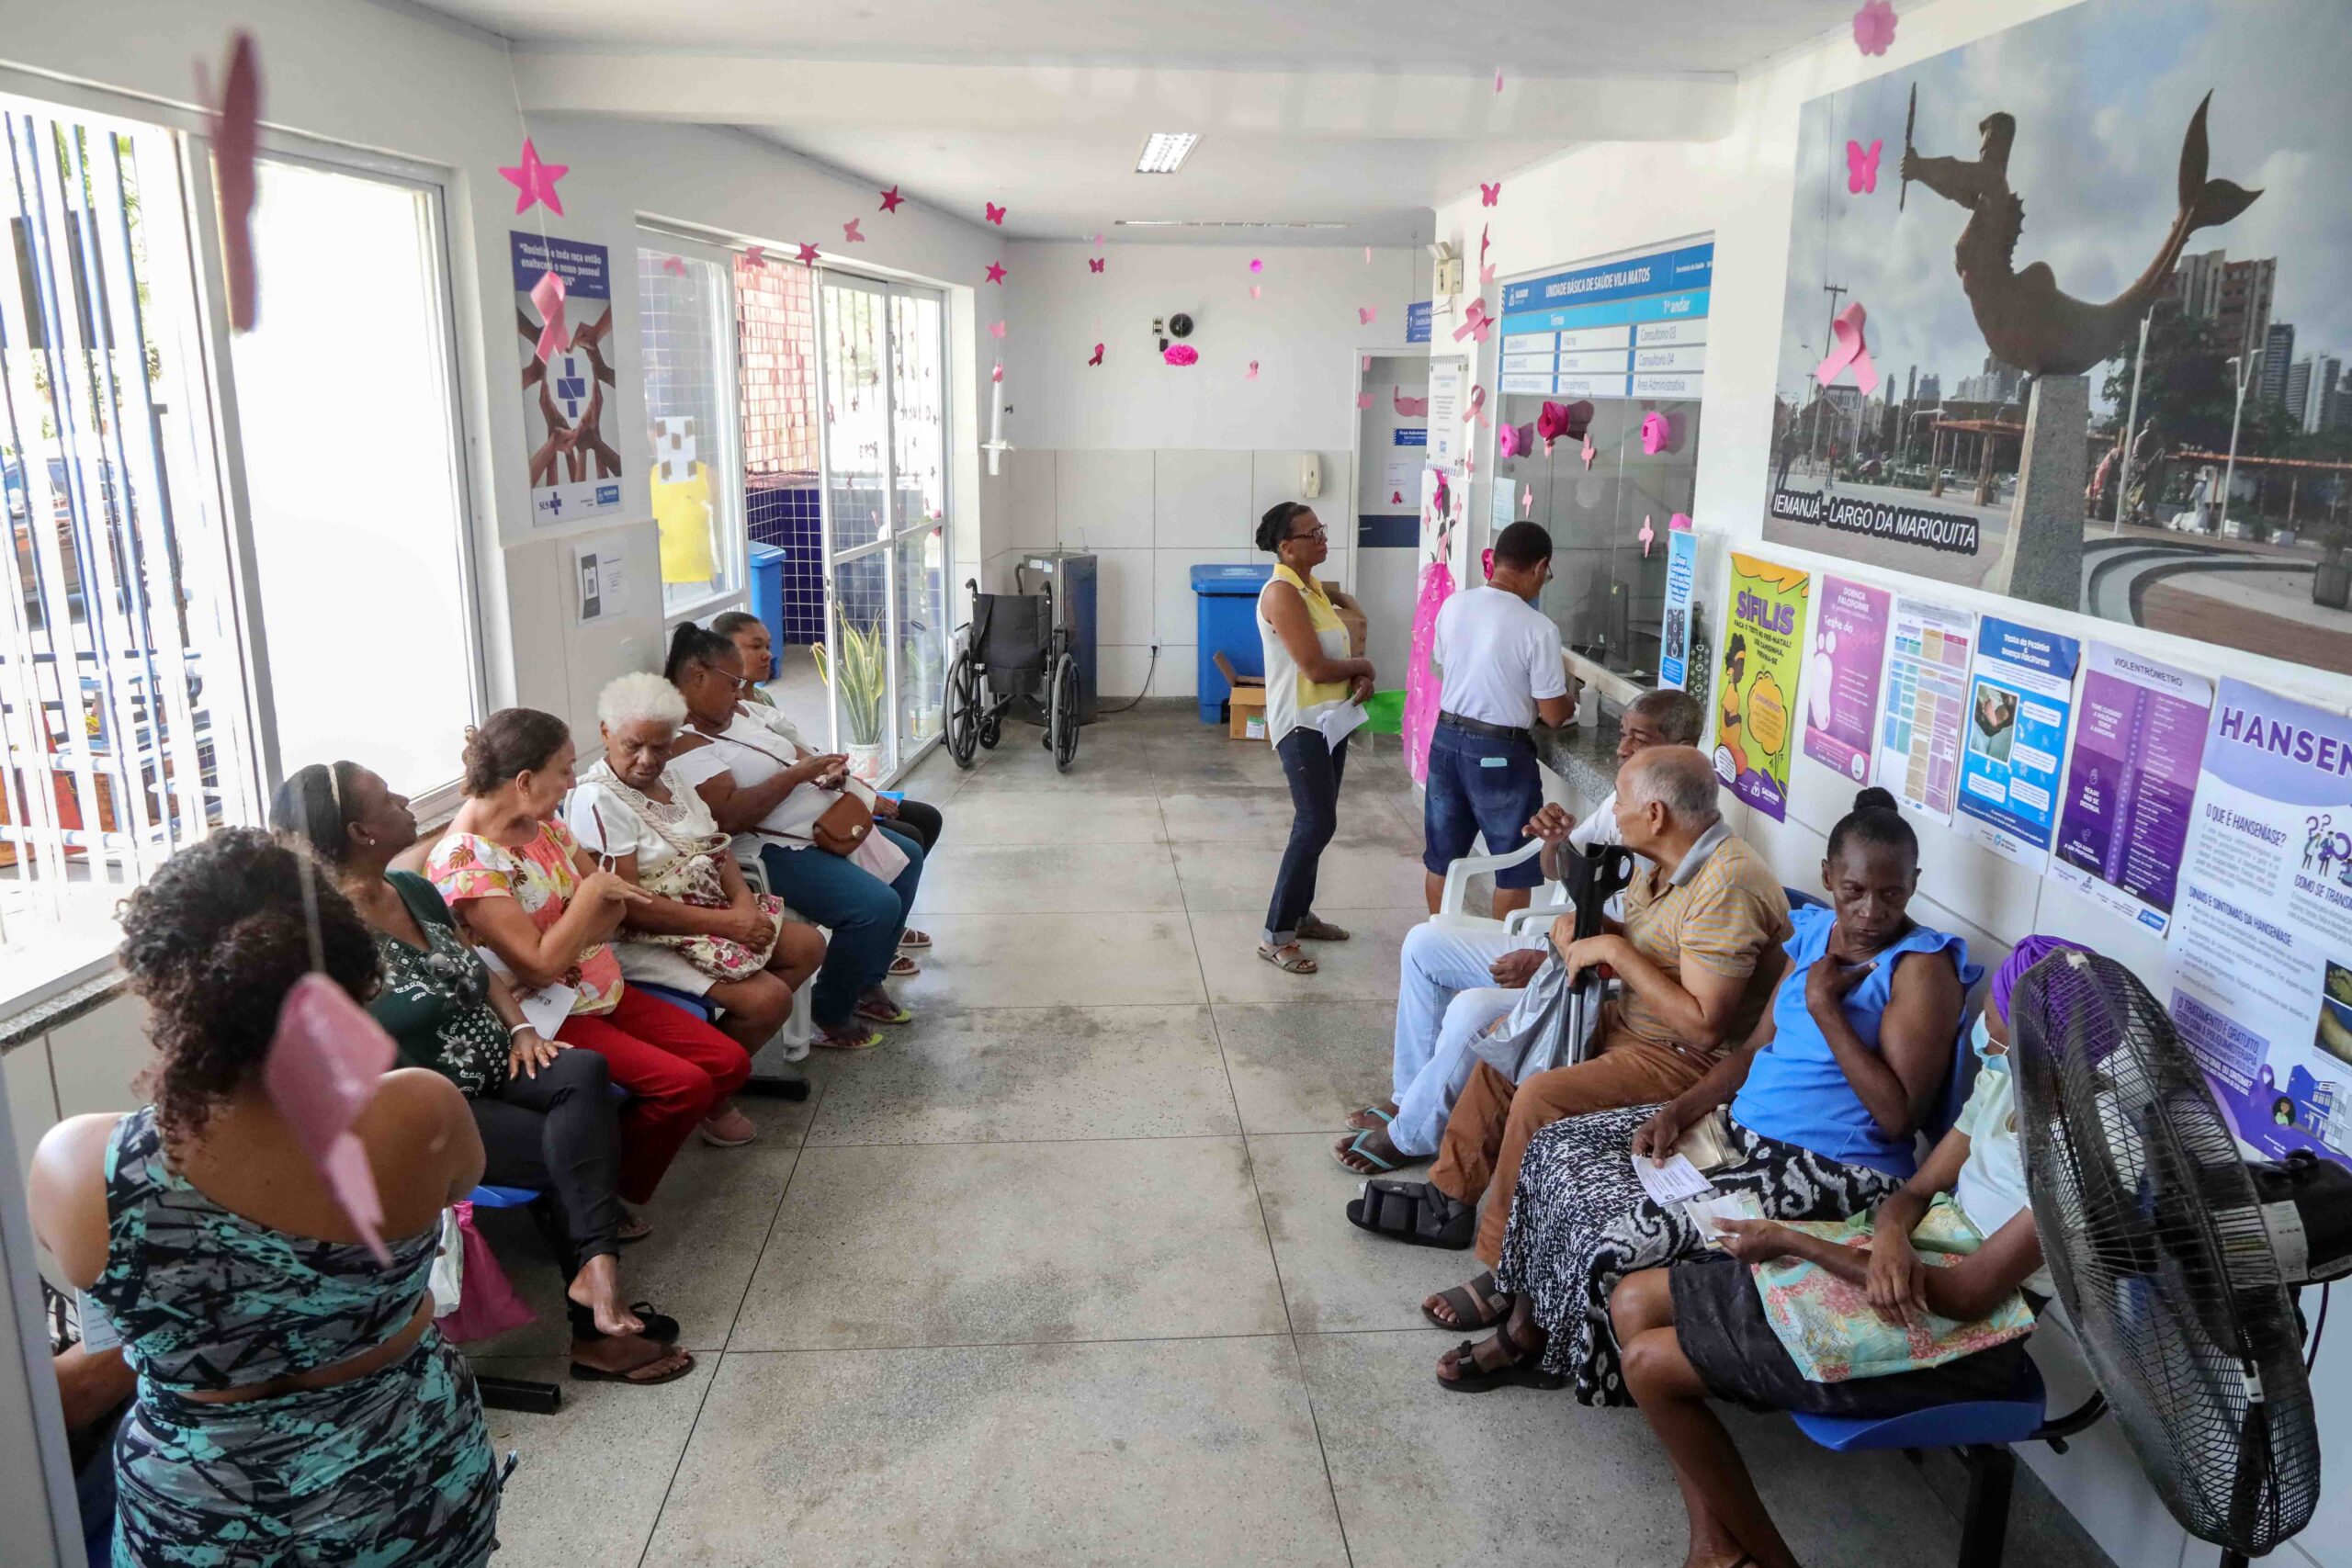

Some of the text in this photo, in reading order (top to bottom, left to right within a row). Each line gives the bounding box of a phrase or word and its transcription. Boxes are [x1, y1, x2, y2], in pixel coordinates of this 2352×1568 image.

[1545, 266, 1651, 299] UNIDADE BÁSICA DE SAÚDE VILA MATOS
[1670, 297, 1690, 314] andar
[1773, 493, 1821, 519] IEMANJÁ
[1828, 502, 1873, 529] LARGO
[1874, 510, 1894, 534] DA
[1894, 513, 1976, 549] MARIQUITA
[1735, 585, 1795, 636] SÍFILIS
[1824, 614, 1854, 635] Teste do
[2206, 803, 2288, 849] O QUE É HANSENÍASE?
[2294, 874, 2316, 894] COMO
[2315, 883, 2325, 898] SE
[2212, 897, 2244, 922] SINTOMAS
[2244, 912, 2253, 926] DA
[2175, 1010, 2190, 1025] FEITO
[2189, 1017, 2202, 1032] COM
[2177, 996, 2184, 1010] O
[2184, 999, 2223, 1033] TRATAMENTO
